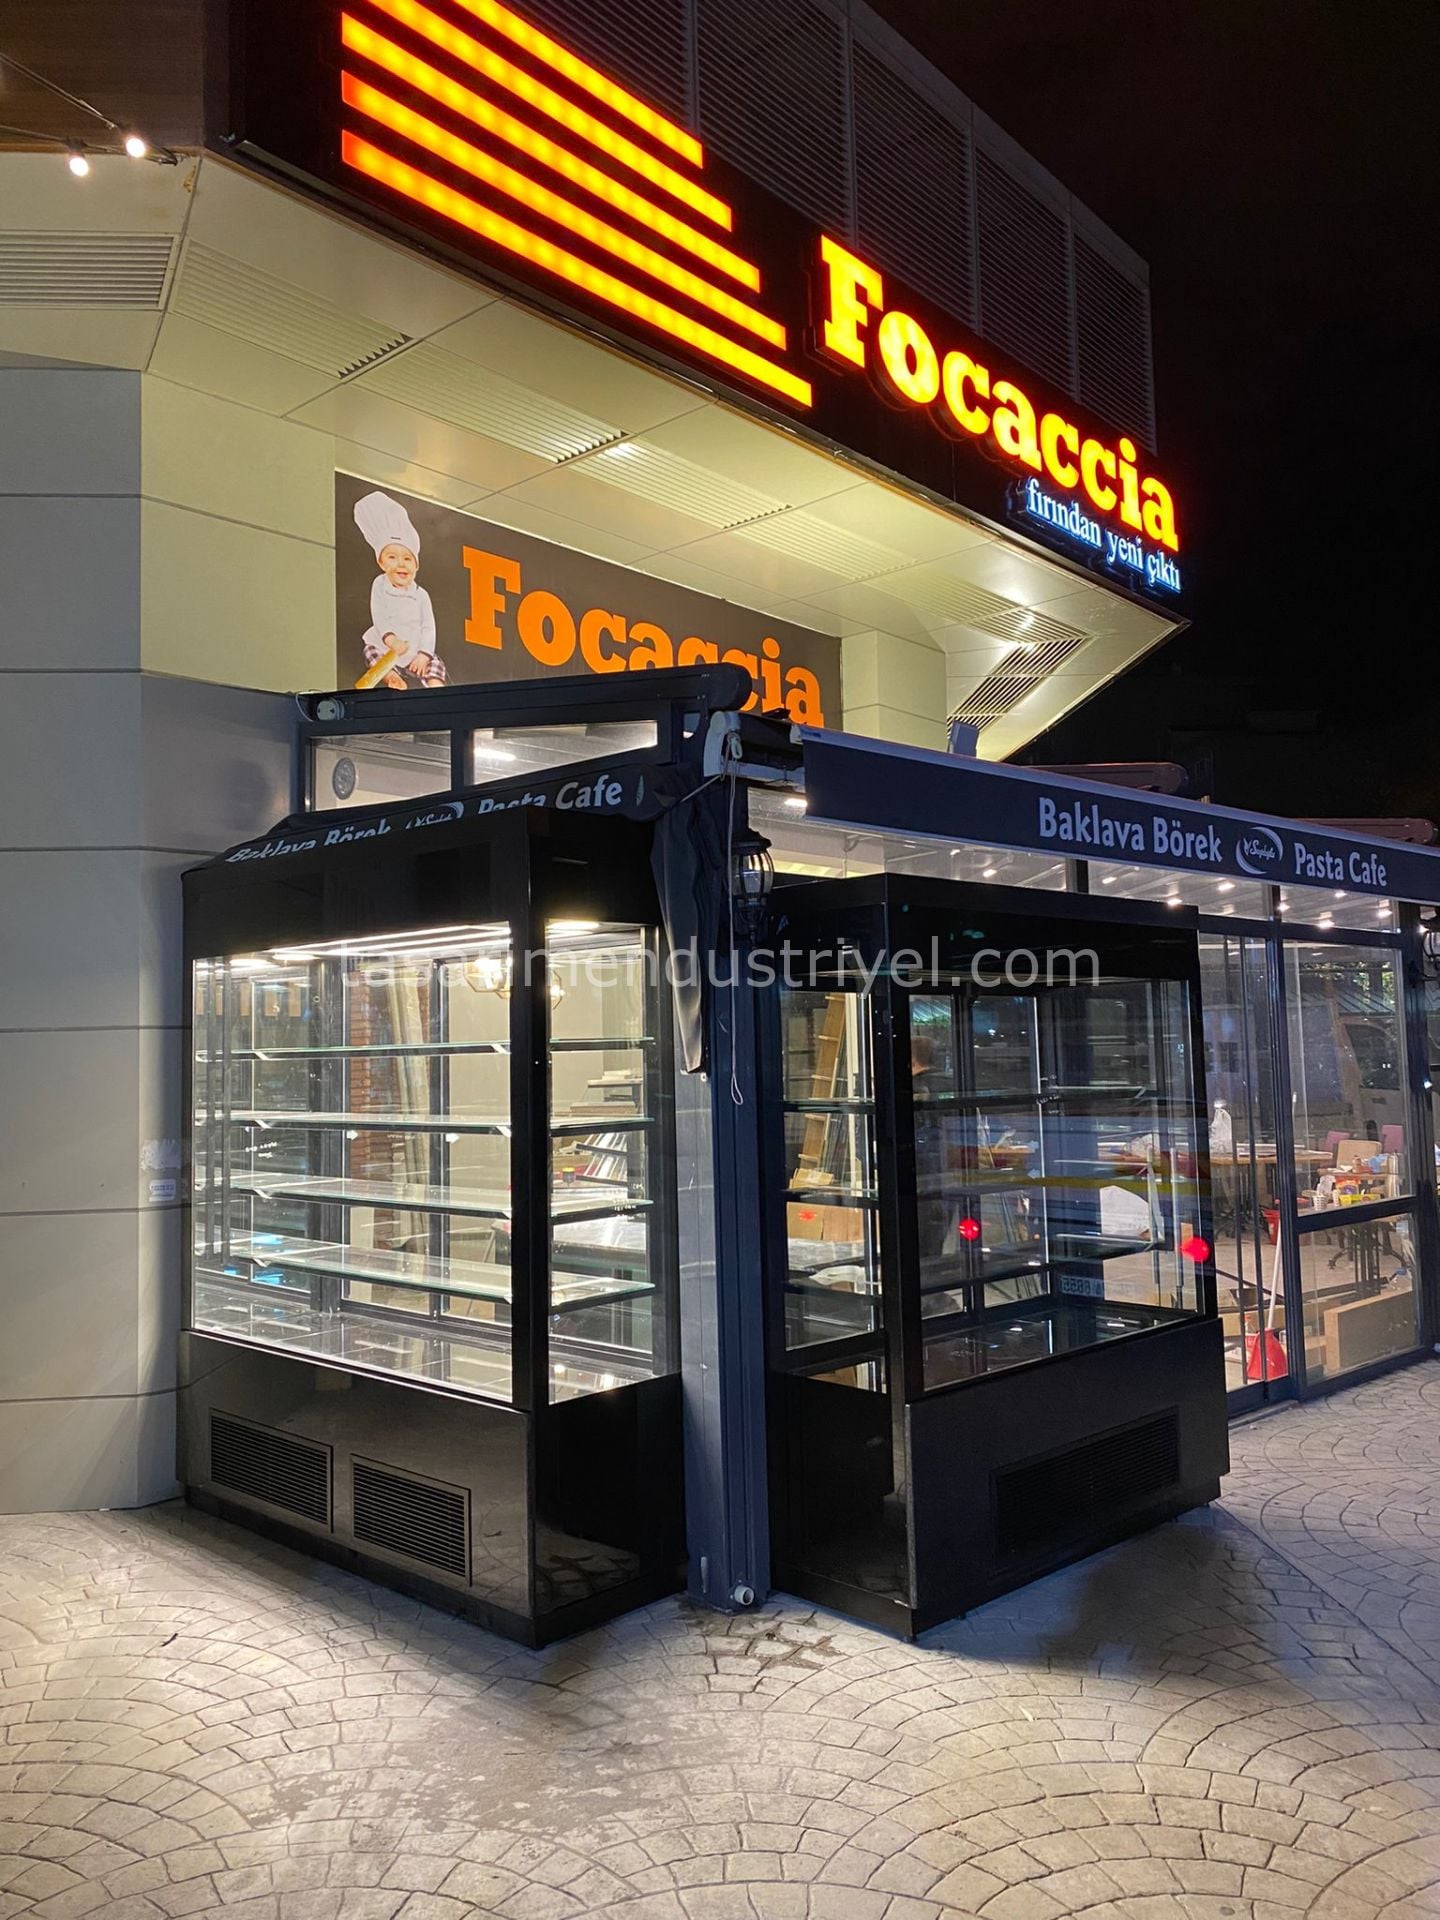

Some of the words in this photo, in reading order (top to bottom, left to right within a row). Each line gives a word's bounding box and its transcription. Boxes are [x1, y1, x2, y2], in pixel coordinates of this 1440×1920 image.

[821, 234, 1179, 552] Focaccia
[1027, 477, 1102, 548] fırından
[1106, 530, 1143, 570] yeni
[1147, 551, 1181, 593] çıktı
[555, 774, 622, 810] Cafe
[1039, 796, 1145, 851] Baklava
[1153, 816, 1223, 863] Börek
[1294, 842, 1344, 881] Pasta
[1349, 851, 1387, 887] Cafe
